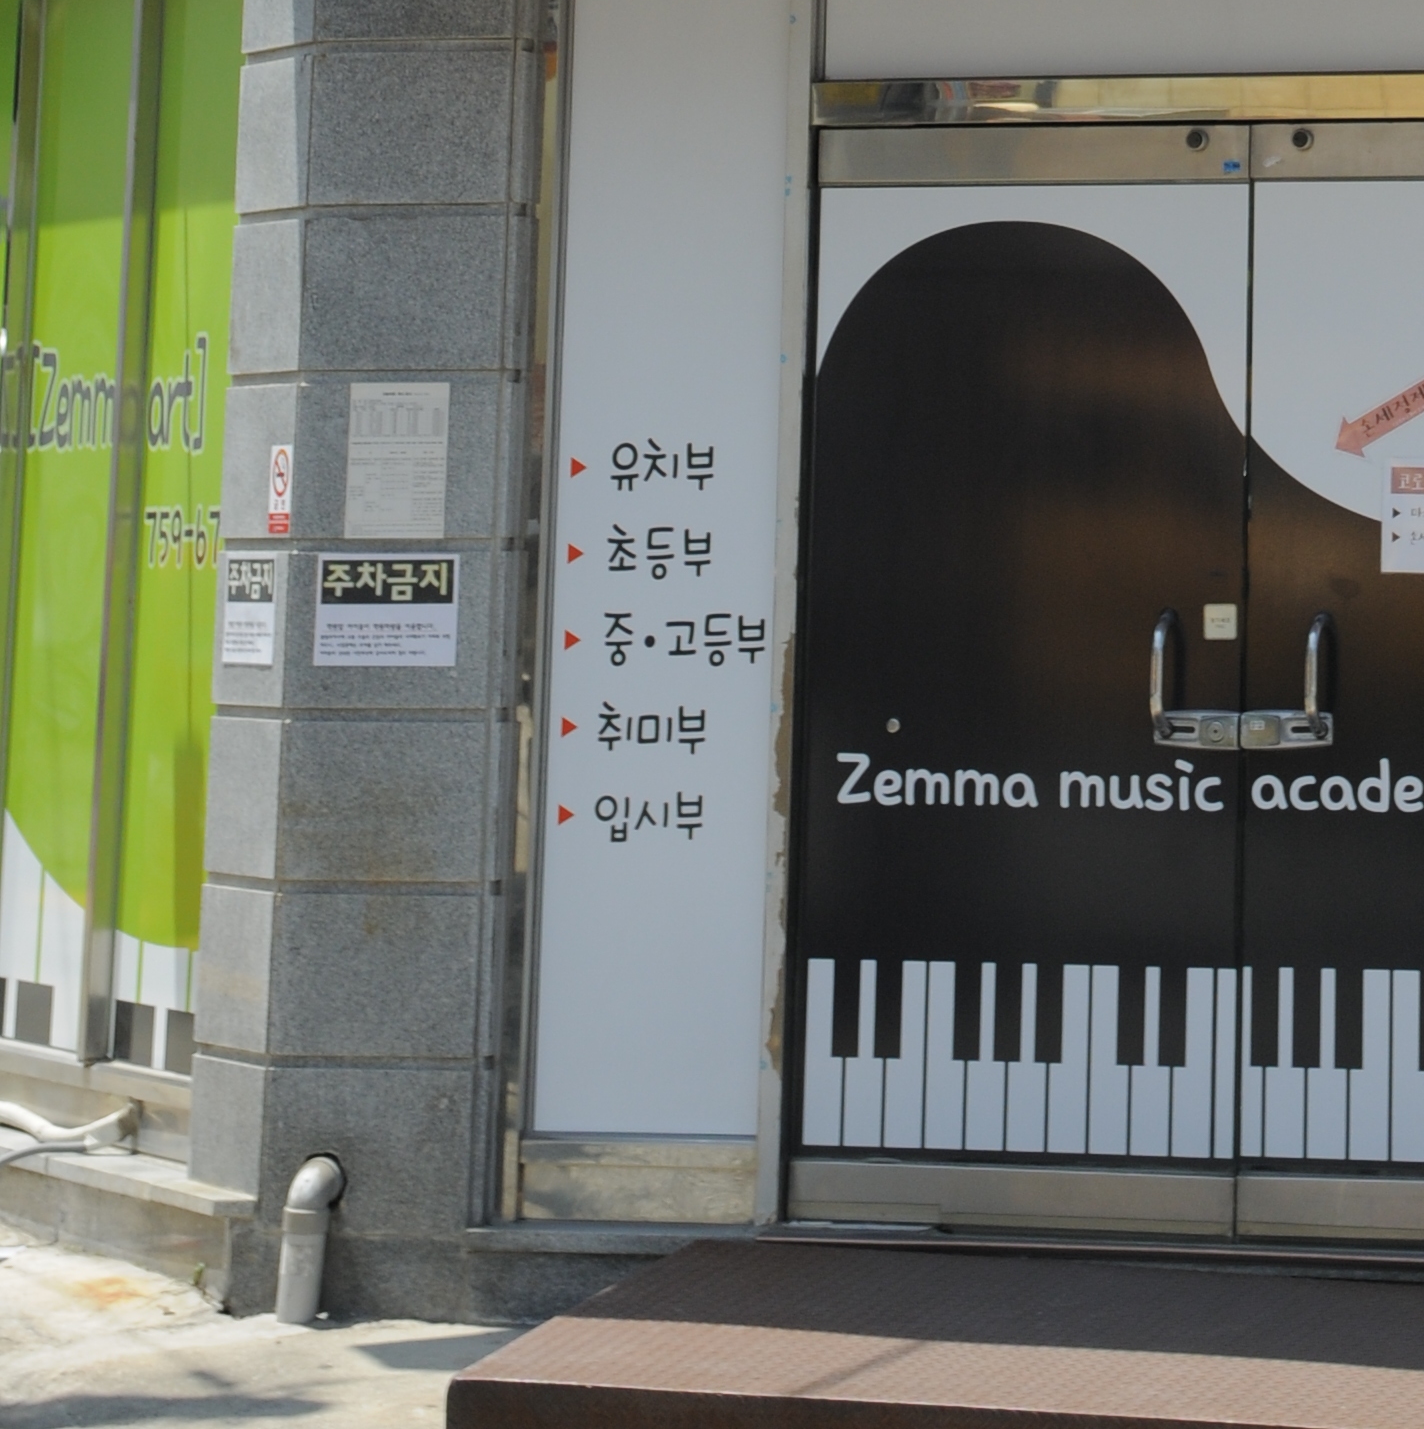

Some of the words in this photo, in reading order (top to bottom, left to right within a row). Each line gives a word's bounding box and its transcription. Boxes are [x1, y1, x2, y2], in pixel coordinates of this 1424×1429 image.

[611, 438, 714, 492] 유치부
[608, 524, 712, 580] 초등부
[229, 561, 273, 600] 주차금지
[324, 562, 448, 601] 주차금지
[598, 701, 706, 755] 취미부
[836, 752, 1039, 808] Zemma
[1059, 759, 1224, 812] music
[594, 791, 703, 843] 입시부
